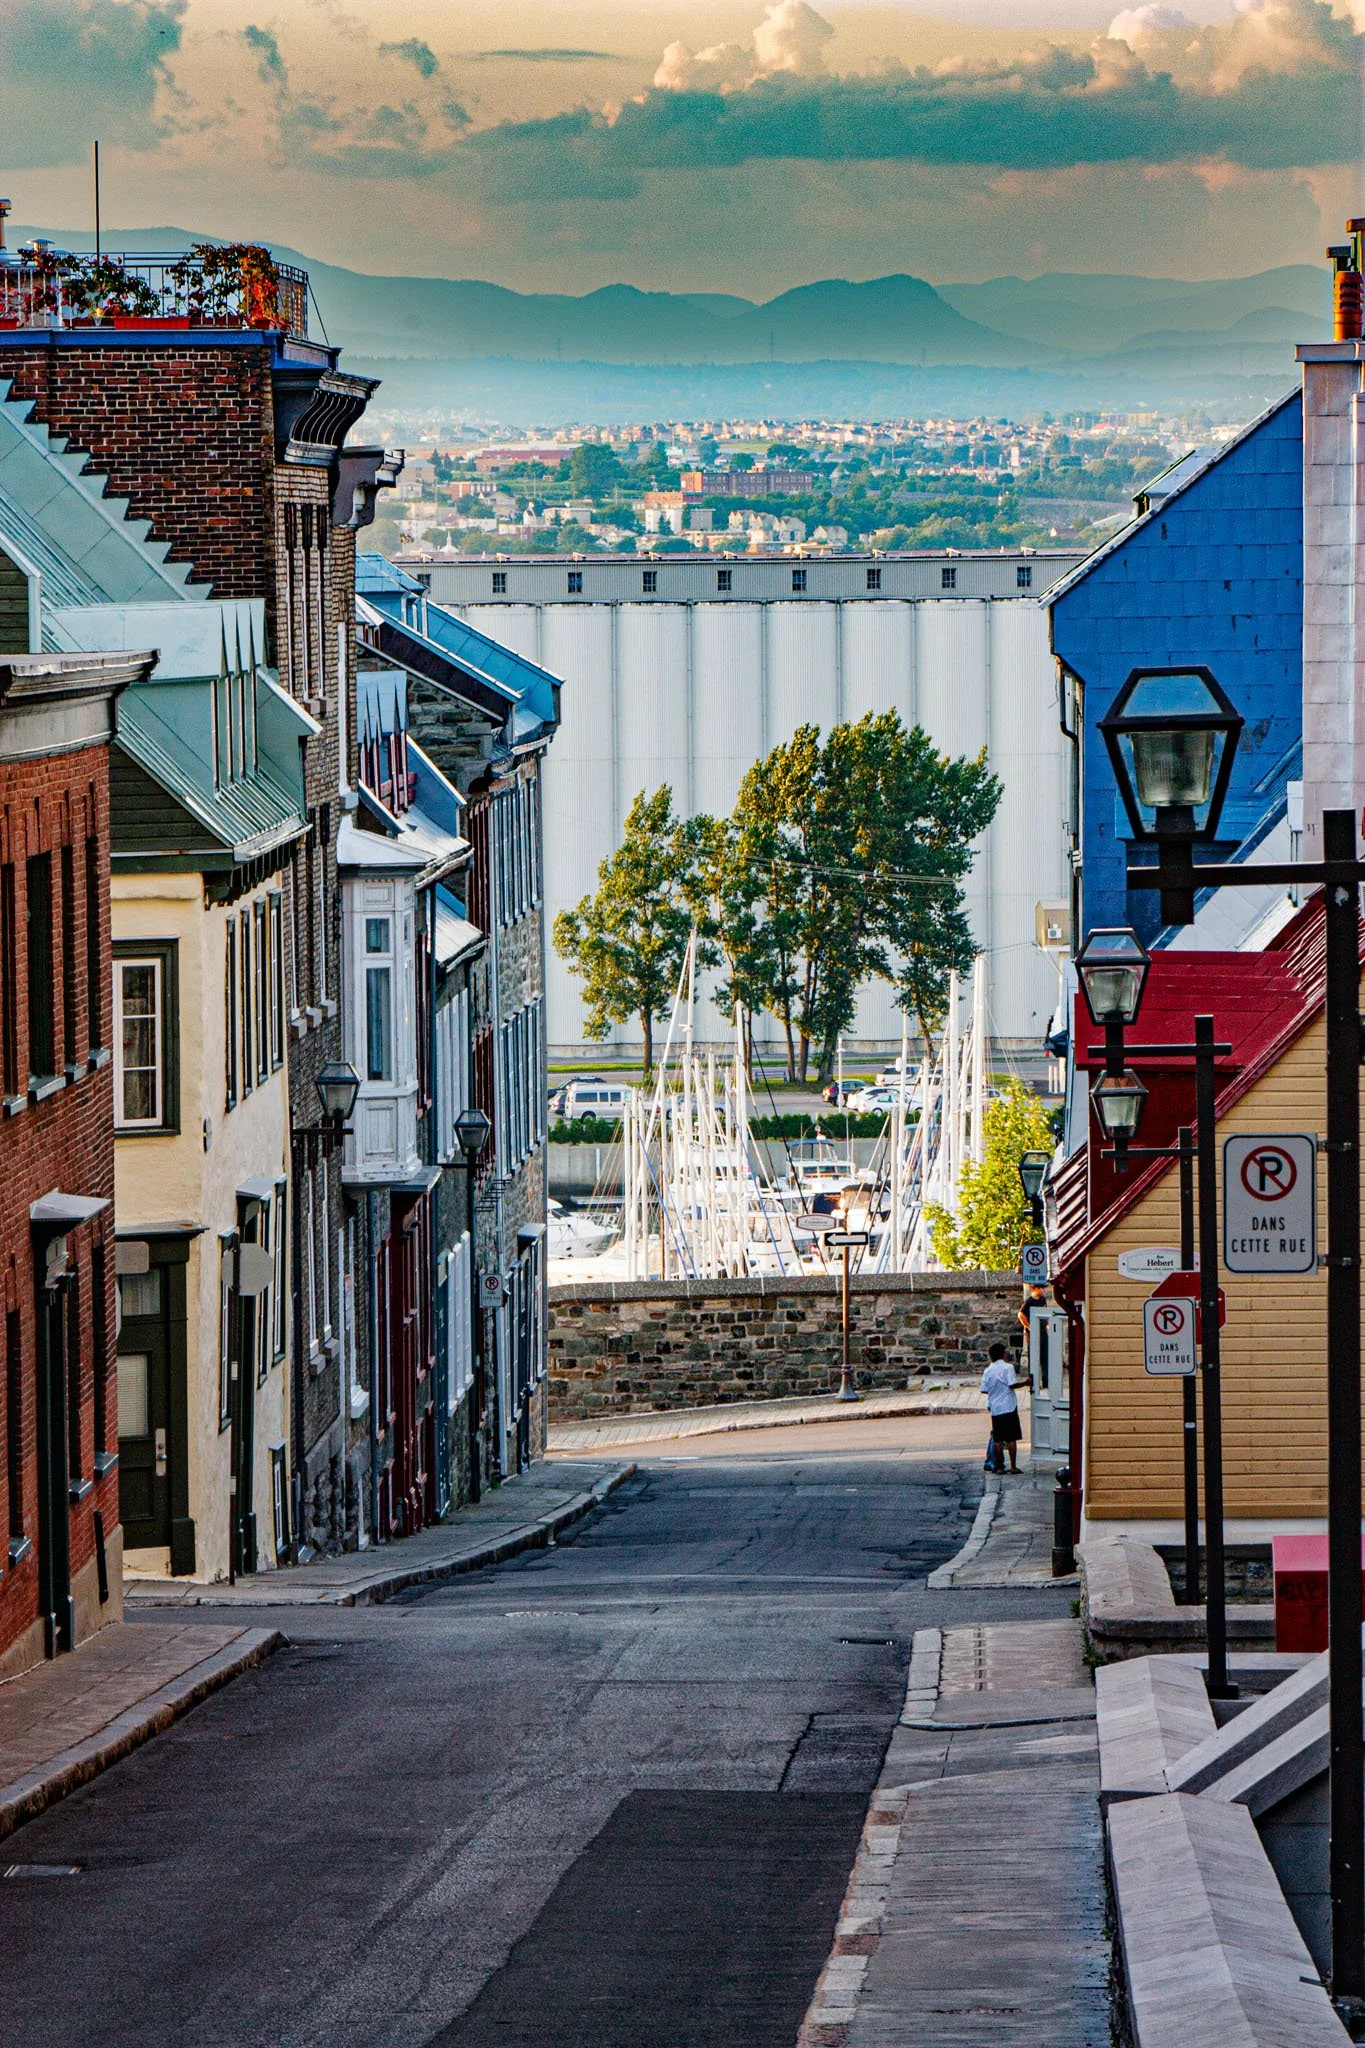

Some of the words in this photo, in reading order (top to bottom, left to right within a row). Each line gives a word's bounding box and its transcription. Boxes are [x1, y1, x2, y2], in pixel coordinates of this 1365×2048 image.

[1252, 1216, 1286, 1231] DANS
[1231, 1238, 1270, 1253] CETTE
[1279, 1238, 1306, 1253] RUE
[1160, 1343, 1179, 1352] DANS
[1149, 1355, 1171, 1364] CETTE
[1175, 1355, 1191, 1364] RUE
